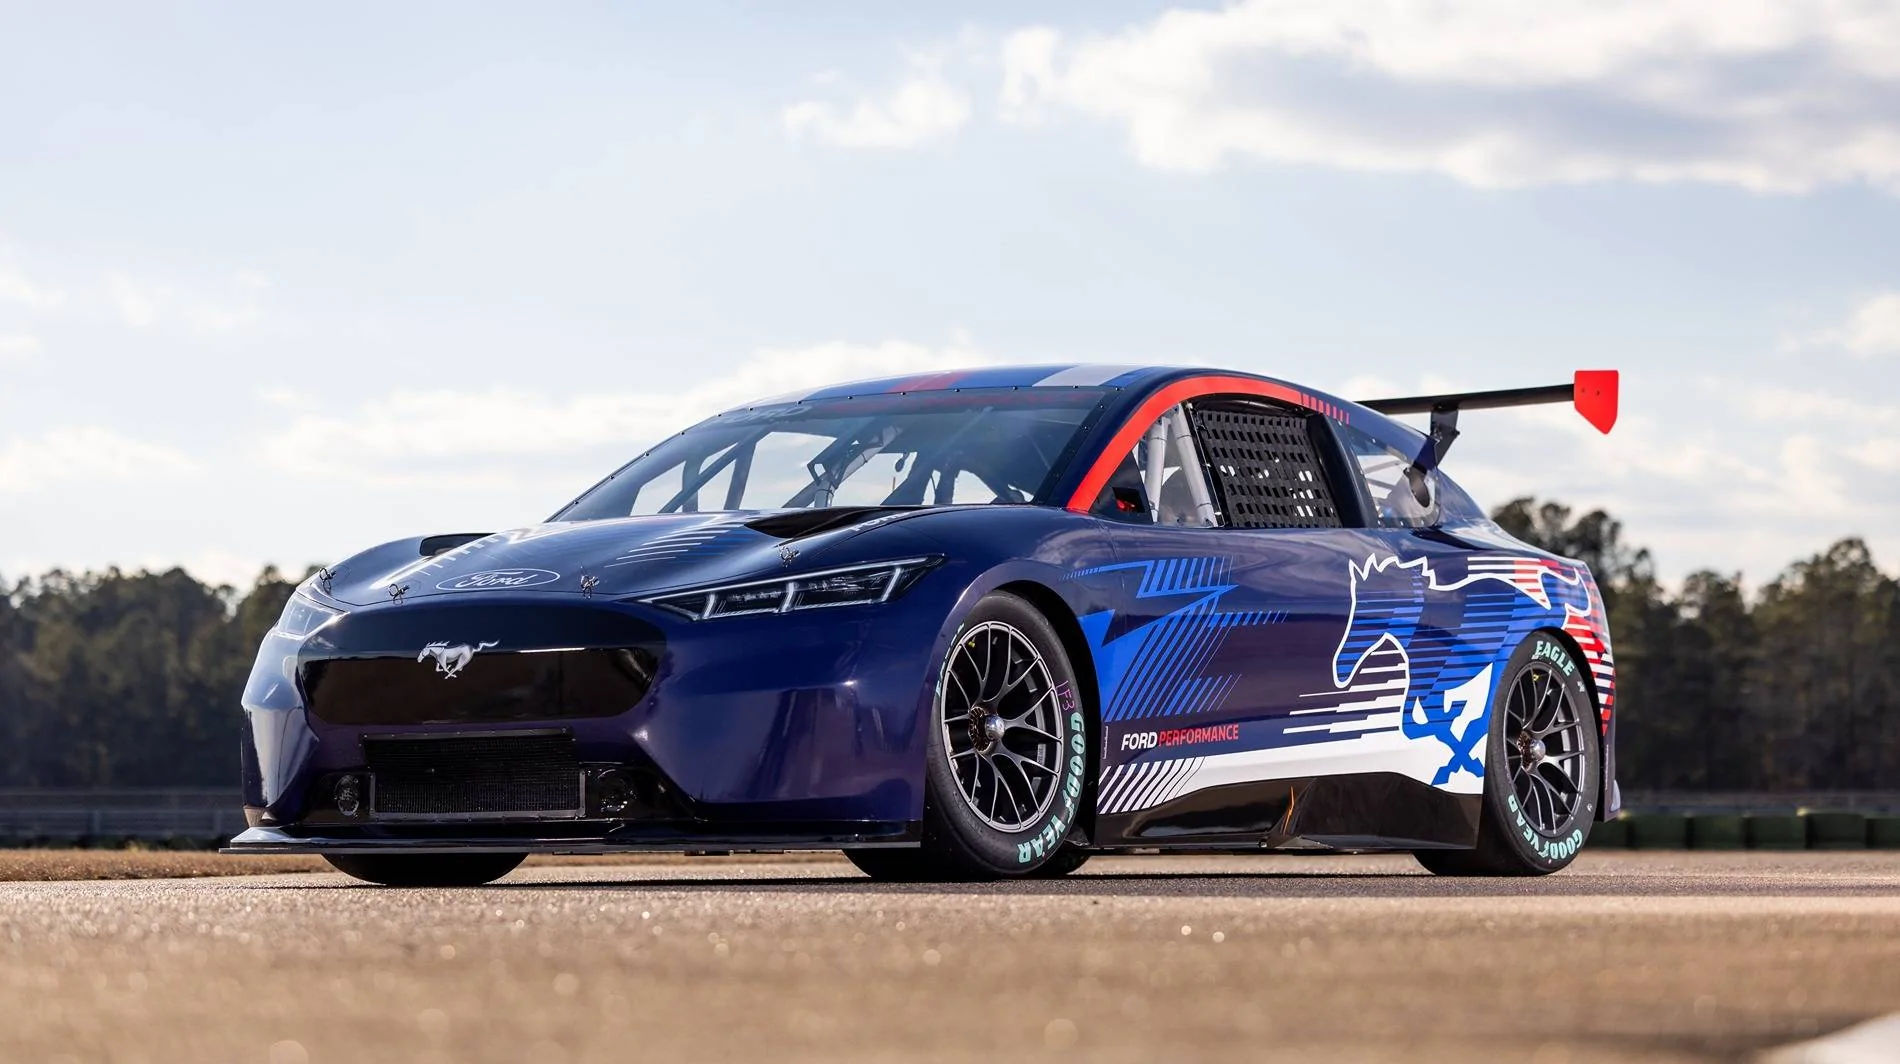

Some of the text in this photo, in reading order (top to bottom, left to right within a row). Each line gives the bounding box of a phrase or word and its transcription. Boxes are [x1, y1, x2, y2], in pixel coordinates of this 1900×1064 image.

[455, 571, 538, 588] Ford
[1534, 640, 1575, 677] EAGLE
[1121, 732, 1158, 751] FORD
[1158, 724, 1240, 747] PERFORMANCE
